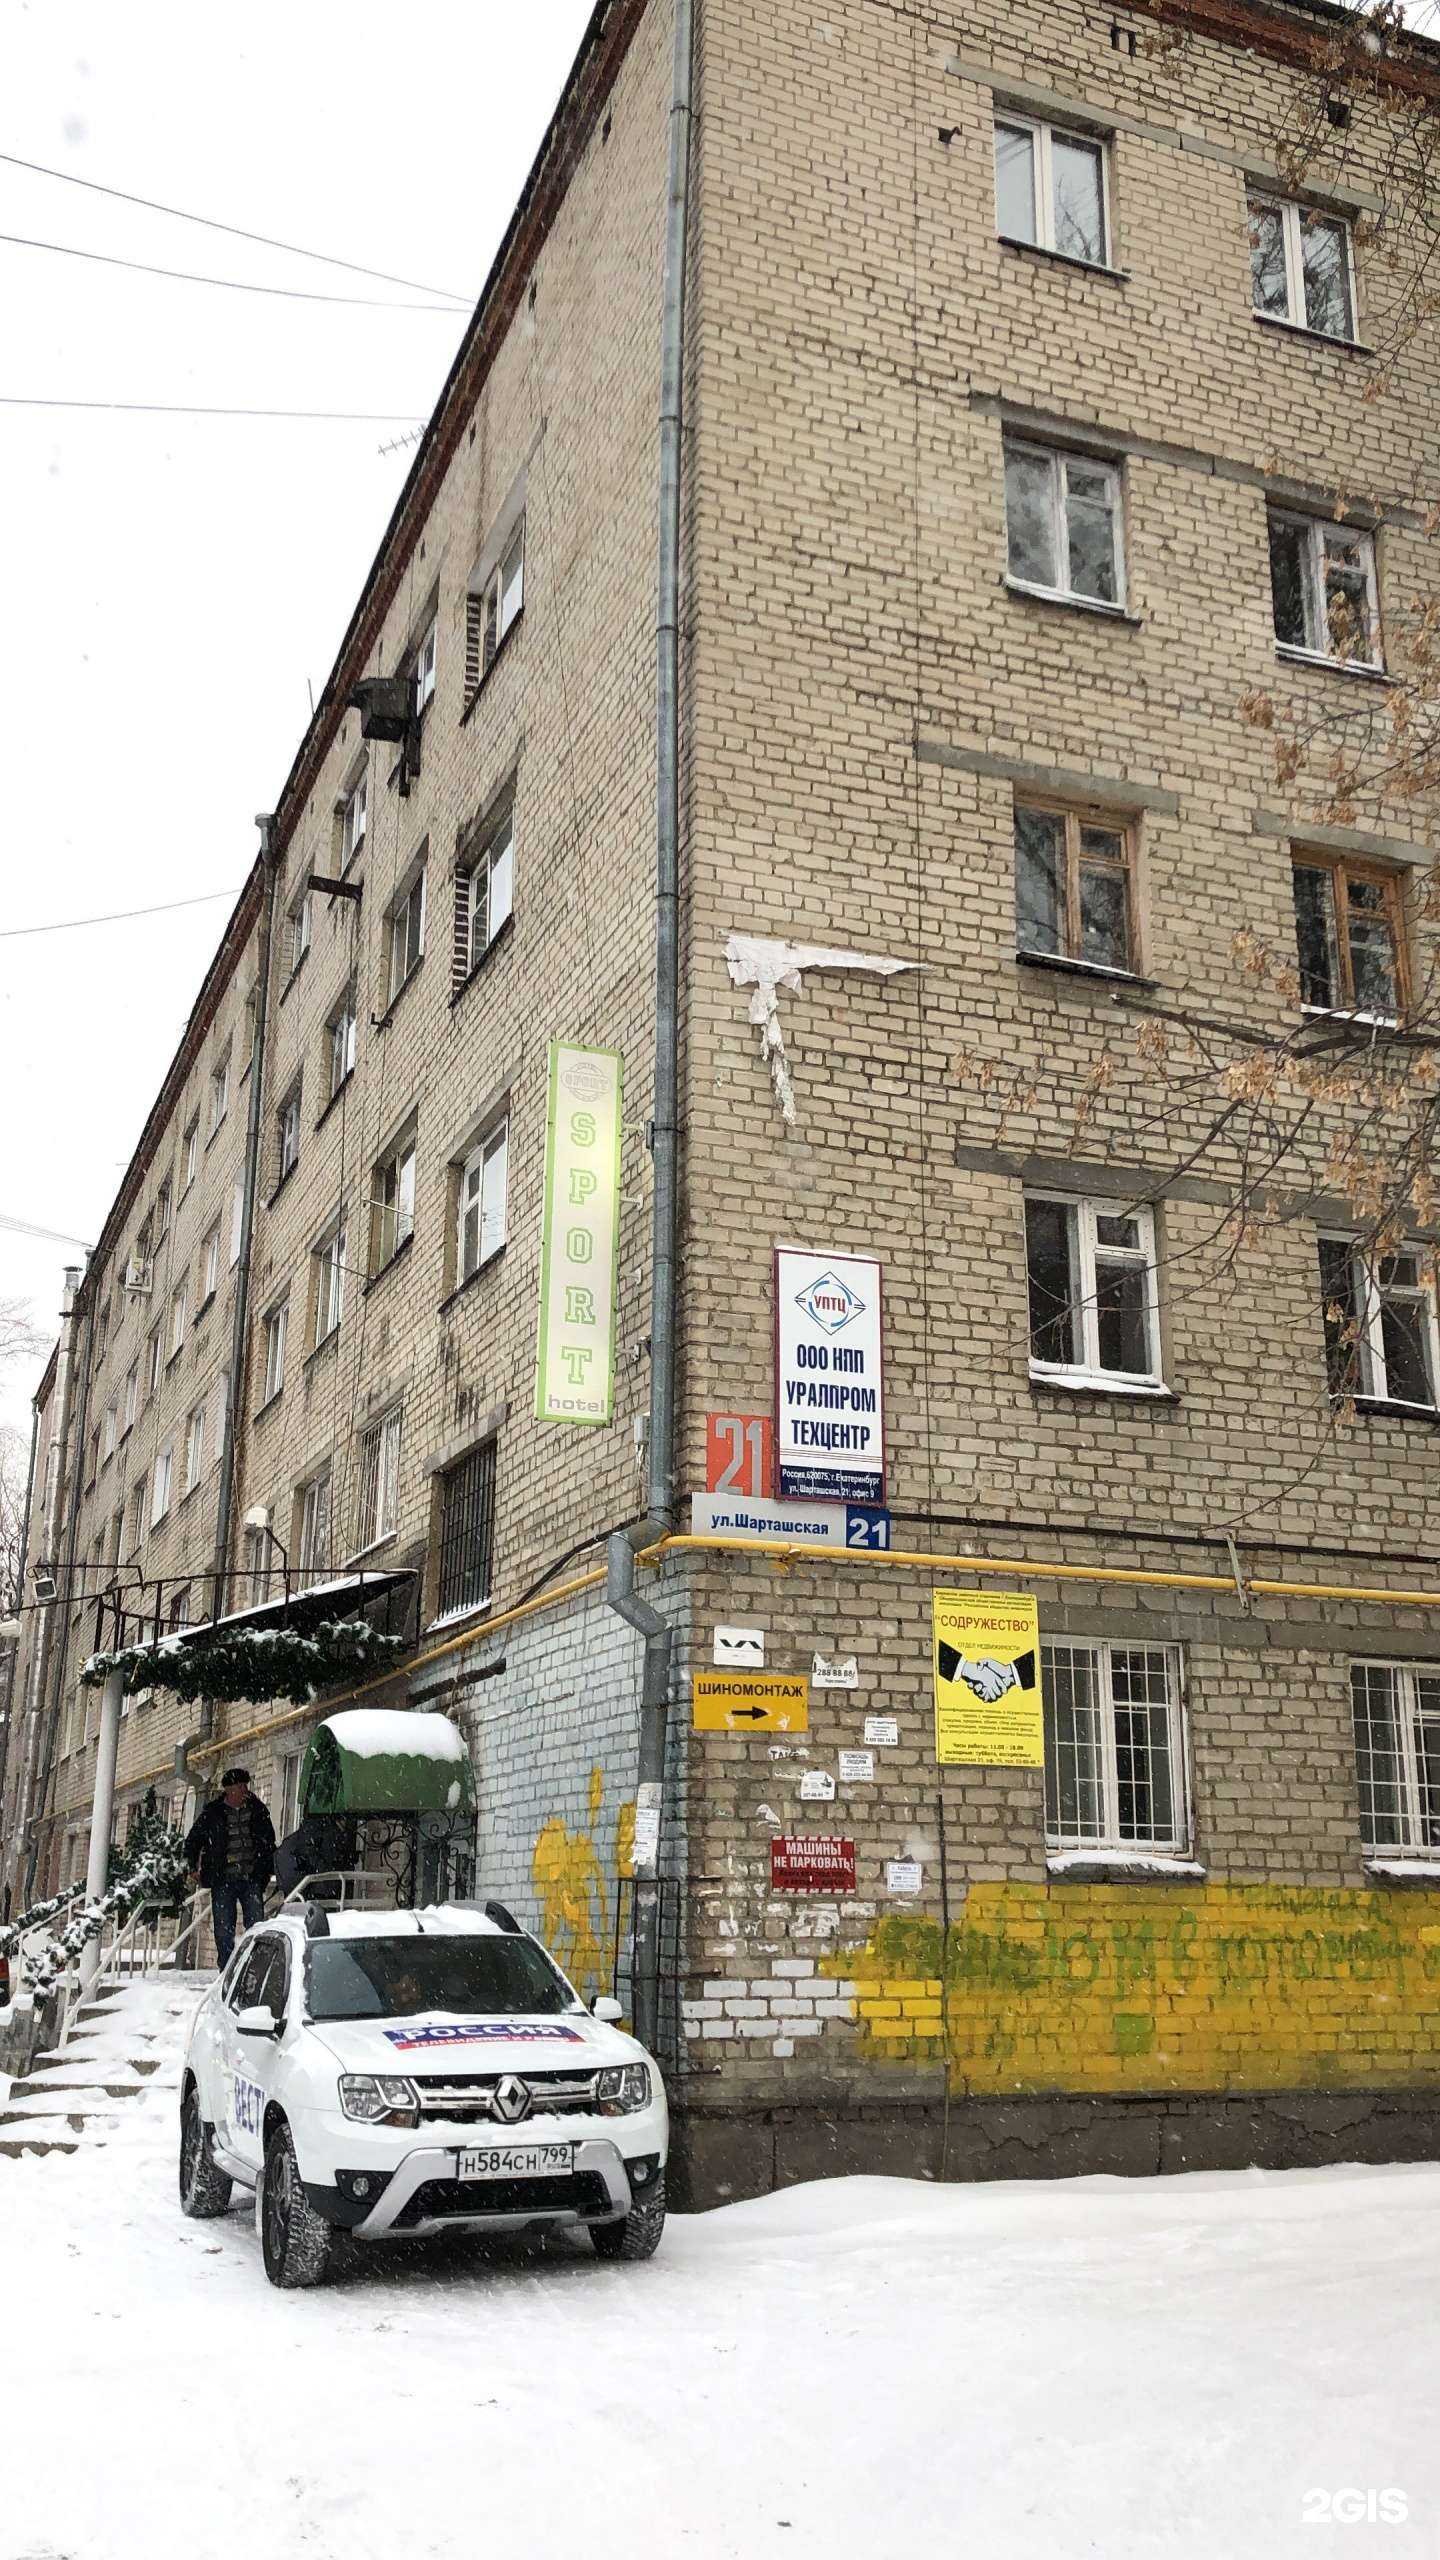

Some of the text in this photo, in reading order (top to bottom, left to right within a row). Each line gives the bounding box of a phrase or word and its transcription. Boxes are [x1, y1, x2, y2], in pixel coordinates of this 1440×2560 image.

[561, 1111, 598, 1386] SPORT
[814, 1295, 846, 1313] УПТЦ
[797, 1344, 864, 1374] ООО НПП
[548, 1394, 605, 1413] hotel
[786, 1380, 876, 1413] УРАЛПРОМ
[791, 1419, 870, 1451] ТЕХЦЕНТР
[714, 1417, 763, 1498] 21
[870, 1490, 875, 1498] 9
[711, 1513, 887, 1547] ул.Шарташская 21
[698, 1683, 804, 1697] ШИНОМОНТАЖ
[786, 1842, 841, 1855] МАШИНЫ
[774, 1856, 854, 1870] НЕ ПАРКОВАТЬ!
[404, 2024, 562, 2041] РОССИЯ
[541, 2147, 568, 2163] 799
